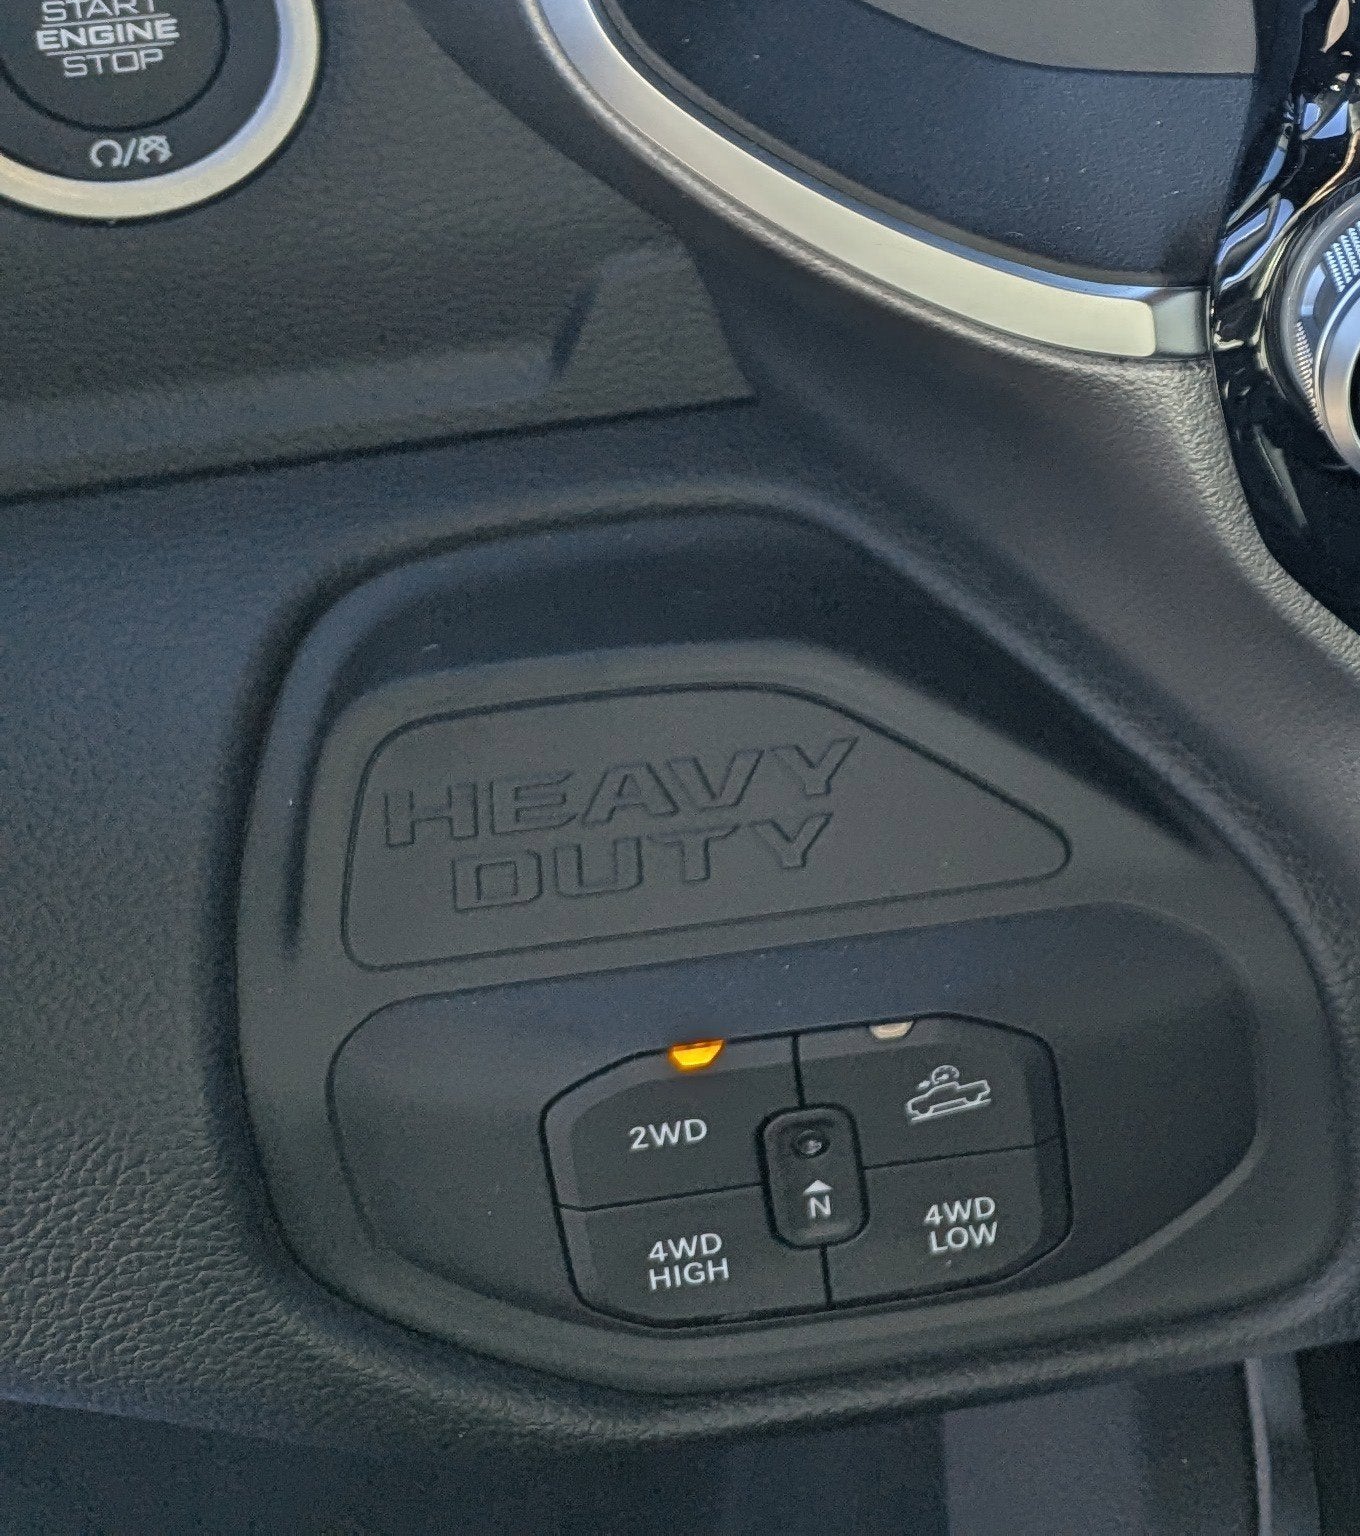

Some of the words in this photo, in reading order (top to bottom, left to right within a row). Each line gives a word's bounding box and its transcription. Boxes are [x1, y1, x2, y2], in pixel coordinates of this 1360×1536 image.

[35, 17, 180, 51] ENGINE
[63, 47, 164, 79] STOP
[383, 736, 858, 848] HEAVY
[452, 811, 834, 914] DUTY
[629, 1118, 708, 1151] 2WD
[808, 1195, 832, 1220] N
[922, 1196, 996, 1226] 4WD
[648, 1231, 723, 1263] 4WD
[930, 1221, 998, 1254] LOW
[648, 1257, 730, 1291] HIGH
